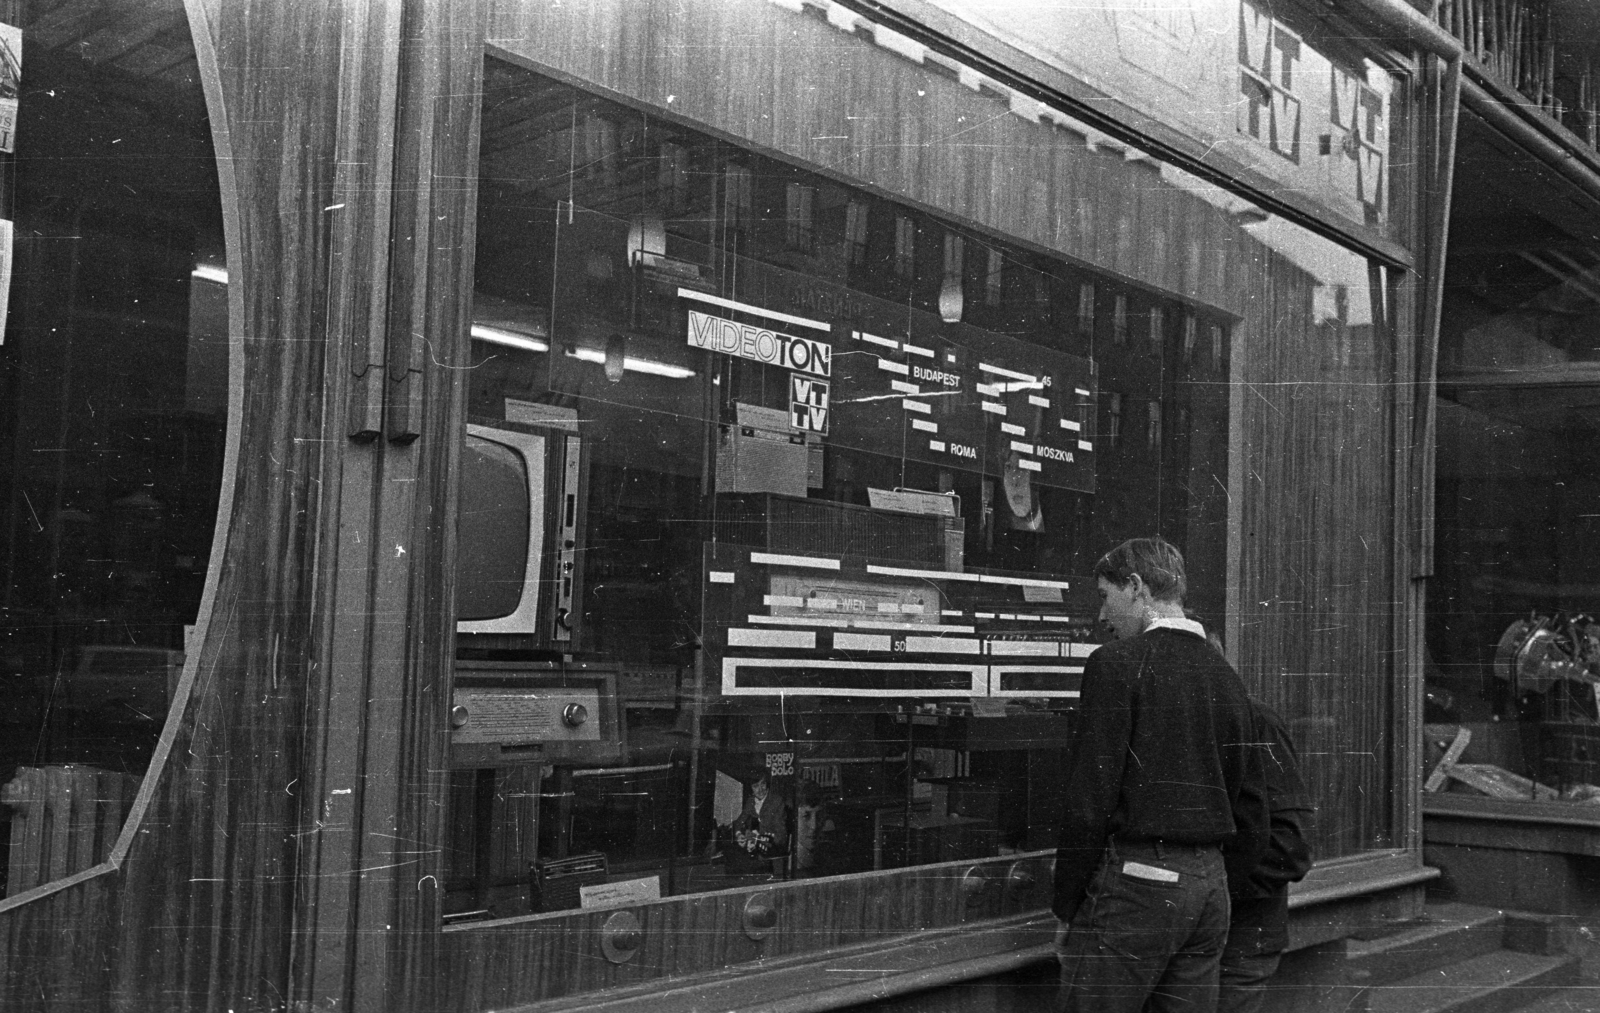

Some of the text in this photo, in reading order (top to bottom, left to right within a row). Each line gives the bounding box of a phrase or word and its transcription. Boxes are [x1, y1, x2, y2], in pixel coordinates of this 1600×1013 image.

[690, 311, 830, 376] VIDEOTON
[913, 366, 961, 387] BUDAPEST
[950, 443, 977, 459] ROMA
[1036, 445, 1074, 463] MOSZKVA
[842, 598, 866, 611] WIEN
[894, 640, 906, 652] 50
